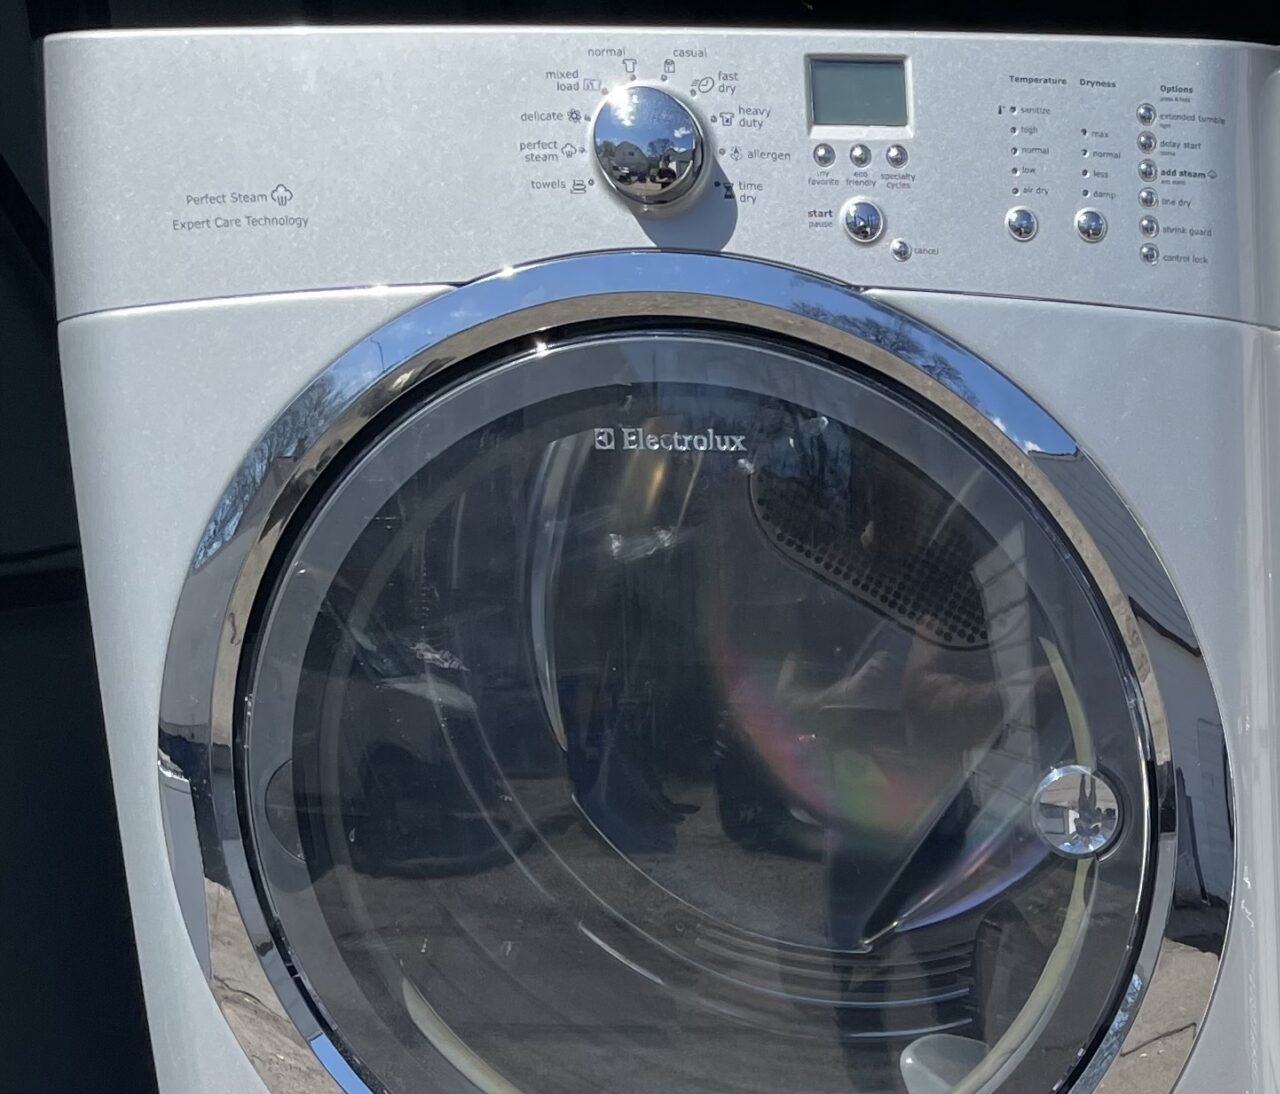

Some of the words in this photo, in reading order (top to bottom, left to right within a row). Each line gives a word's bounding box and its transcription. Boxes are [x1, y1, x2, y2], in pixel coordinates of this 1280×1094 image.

[588, 48, 626, 56] normal
[673, 47, 707, 57] casual
[545, 70, 579, 79] mixed
[718, 70, 739, 81] fast
[1009, 75, 1067, 85] Temperature
[1079, 79, 1116, 88] Dryness
[556, 82, 580, 91] load
[718, 83, 736, 95] dry
[1160, 85, 1193, 94] Options
[738, 105, 771, 117] heavy
[1020, 106, 1050, 114] sanitize
[521, 111, 563, 121] delicate
[739, 117, 764, 129] duty
[1021, 126, 1038, 135] high
[520, 140, 557, 152] perfect
[1021, 146, 1049, 154] normal
[1183, 141, 1201, 150] start
[525, 152, 558, 161] steam
[747, 150, 791, 161] allergen
[1092, 151, 1121, 159] normal
[1022, 166, 1036, 174] low
[1093, 170, 1108, 178] less
[1160, 169, 1177, 177] add
[1179, 170, 1206, 179] steam
[808, 178, 839, 186] favorite
[881, 173, 916, 182] specialty
[531, 179, 566, 189] towels
[738, 182, 763, 191] time
[846, 179, 876, 188] friendly
[886, 181, 911, 190] cycles
[1023, 186, 1034, 194] air
[1035, 187, 1049, 196] dry
[1093, 190, 1116, 200] damp
[186, 193, 226, 205] Perfect
[230, 193, 267, 203] Steam
[739, 192, 757, 203] dry
[1178, 199, 1191, 208] dry
[807, 209, 833, 218] start
[173, 219, 211, 231] Expert
[214, 217, 241, 228] Care
[245, 215, 309, 228] Technology
[914, 247, 939, 255] cancel
[622, 428, 748, 451] Electrolux
